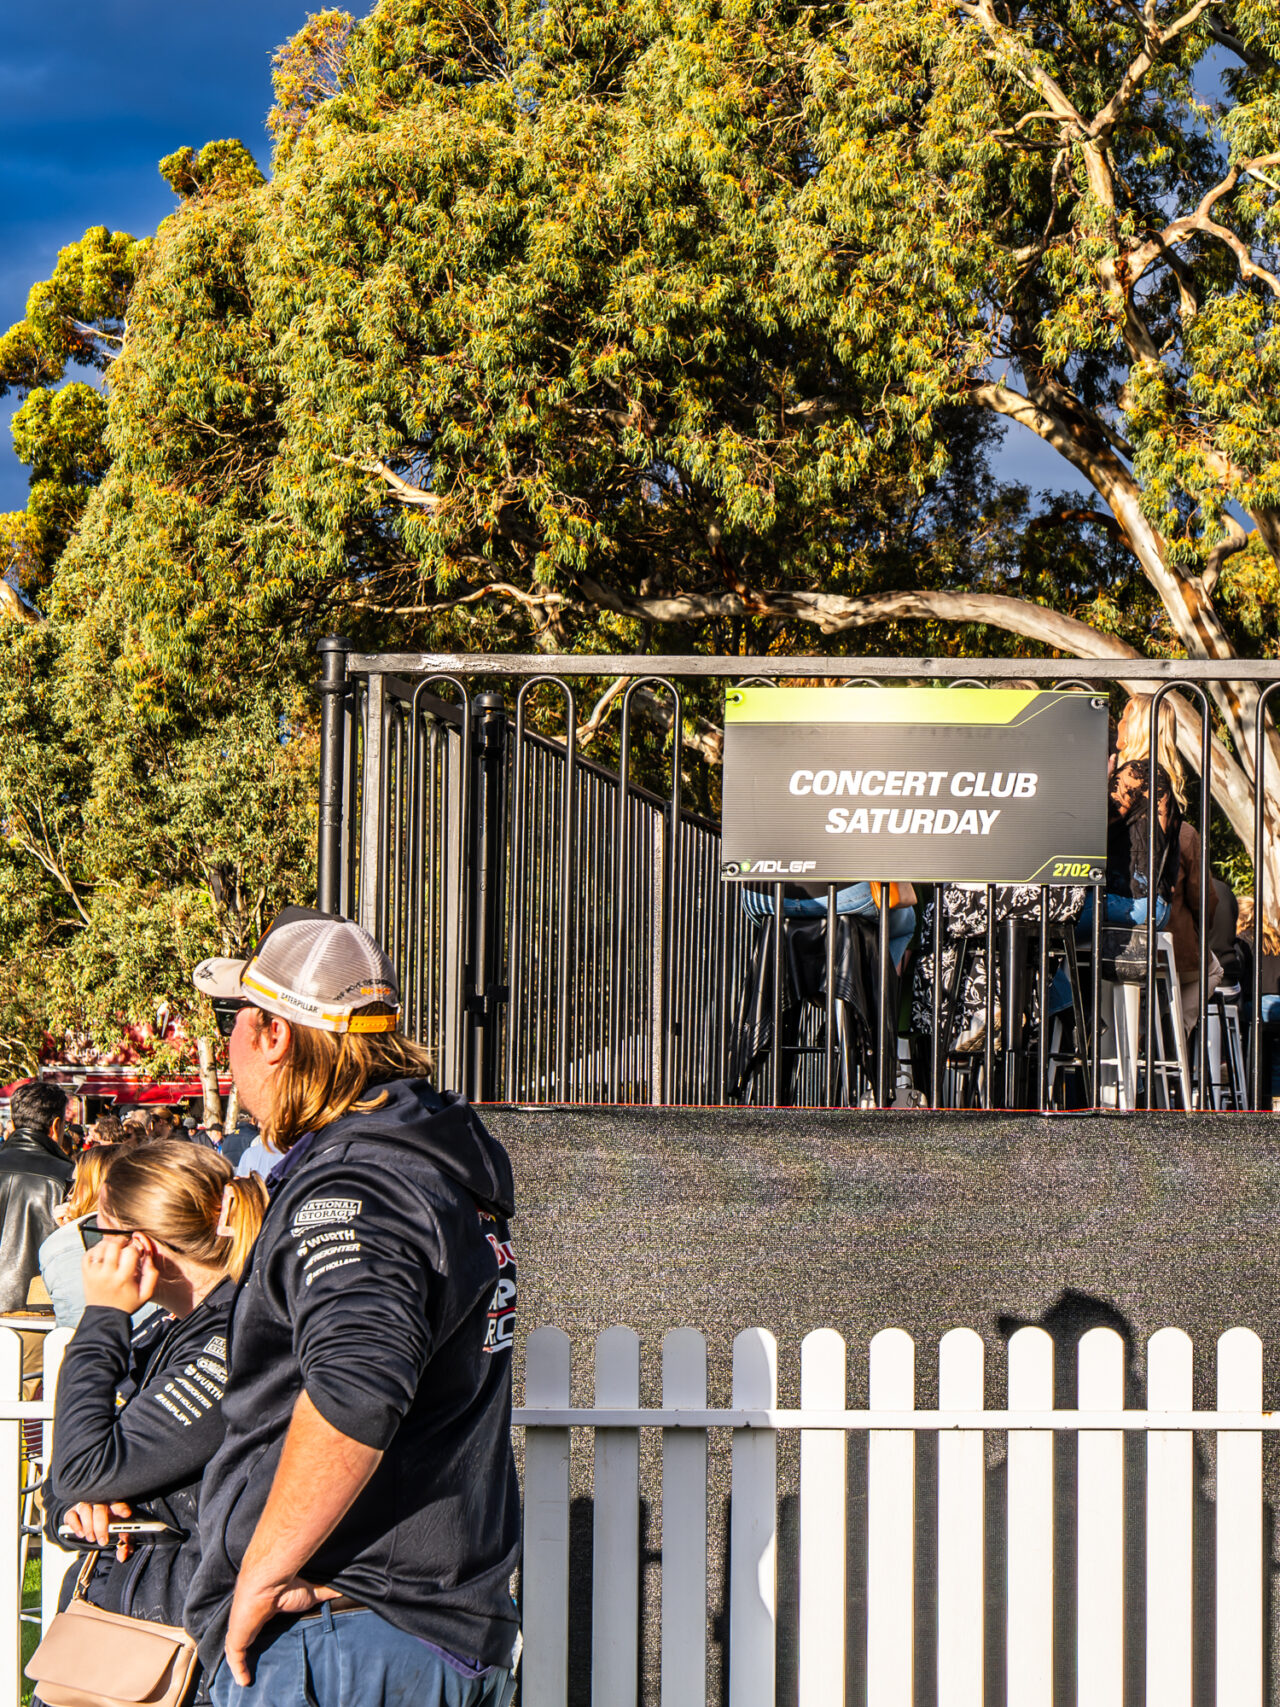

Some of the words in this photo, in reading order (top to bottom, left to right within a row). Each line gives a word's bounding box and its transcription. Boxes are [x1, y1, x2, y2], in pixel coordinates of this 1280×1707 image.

[788, 769, 949, 797] CONCERT
[949, 771, 1039, 798] CLUB
[825, 807, 1002, 835] SATURDAY
[749, 860, 817, 873] ADLGF
[1052, 862, 1091, 877] 2702
[280, 992, 319, 1013] CATERPILLAR
[301, 1201, 357, 1212] NATIONAL
[301, 1210, 353, 1220] STORAGE
